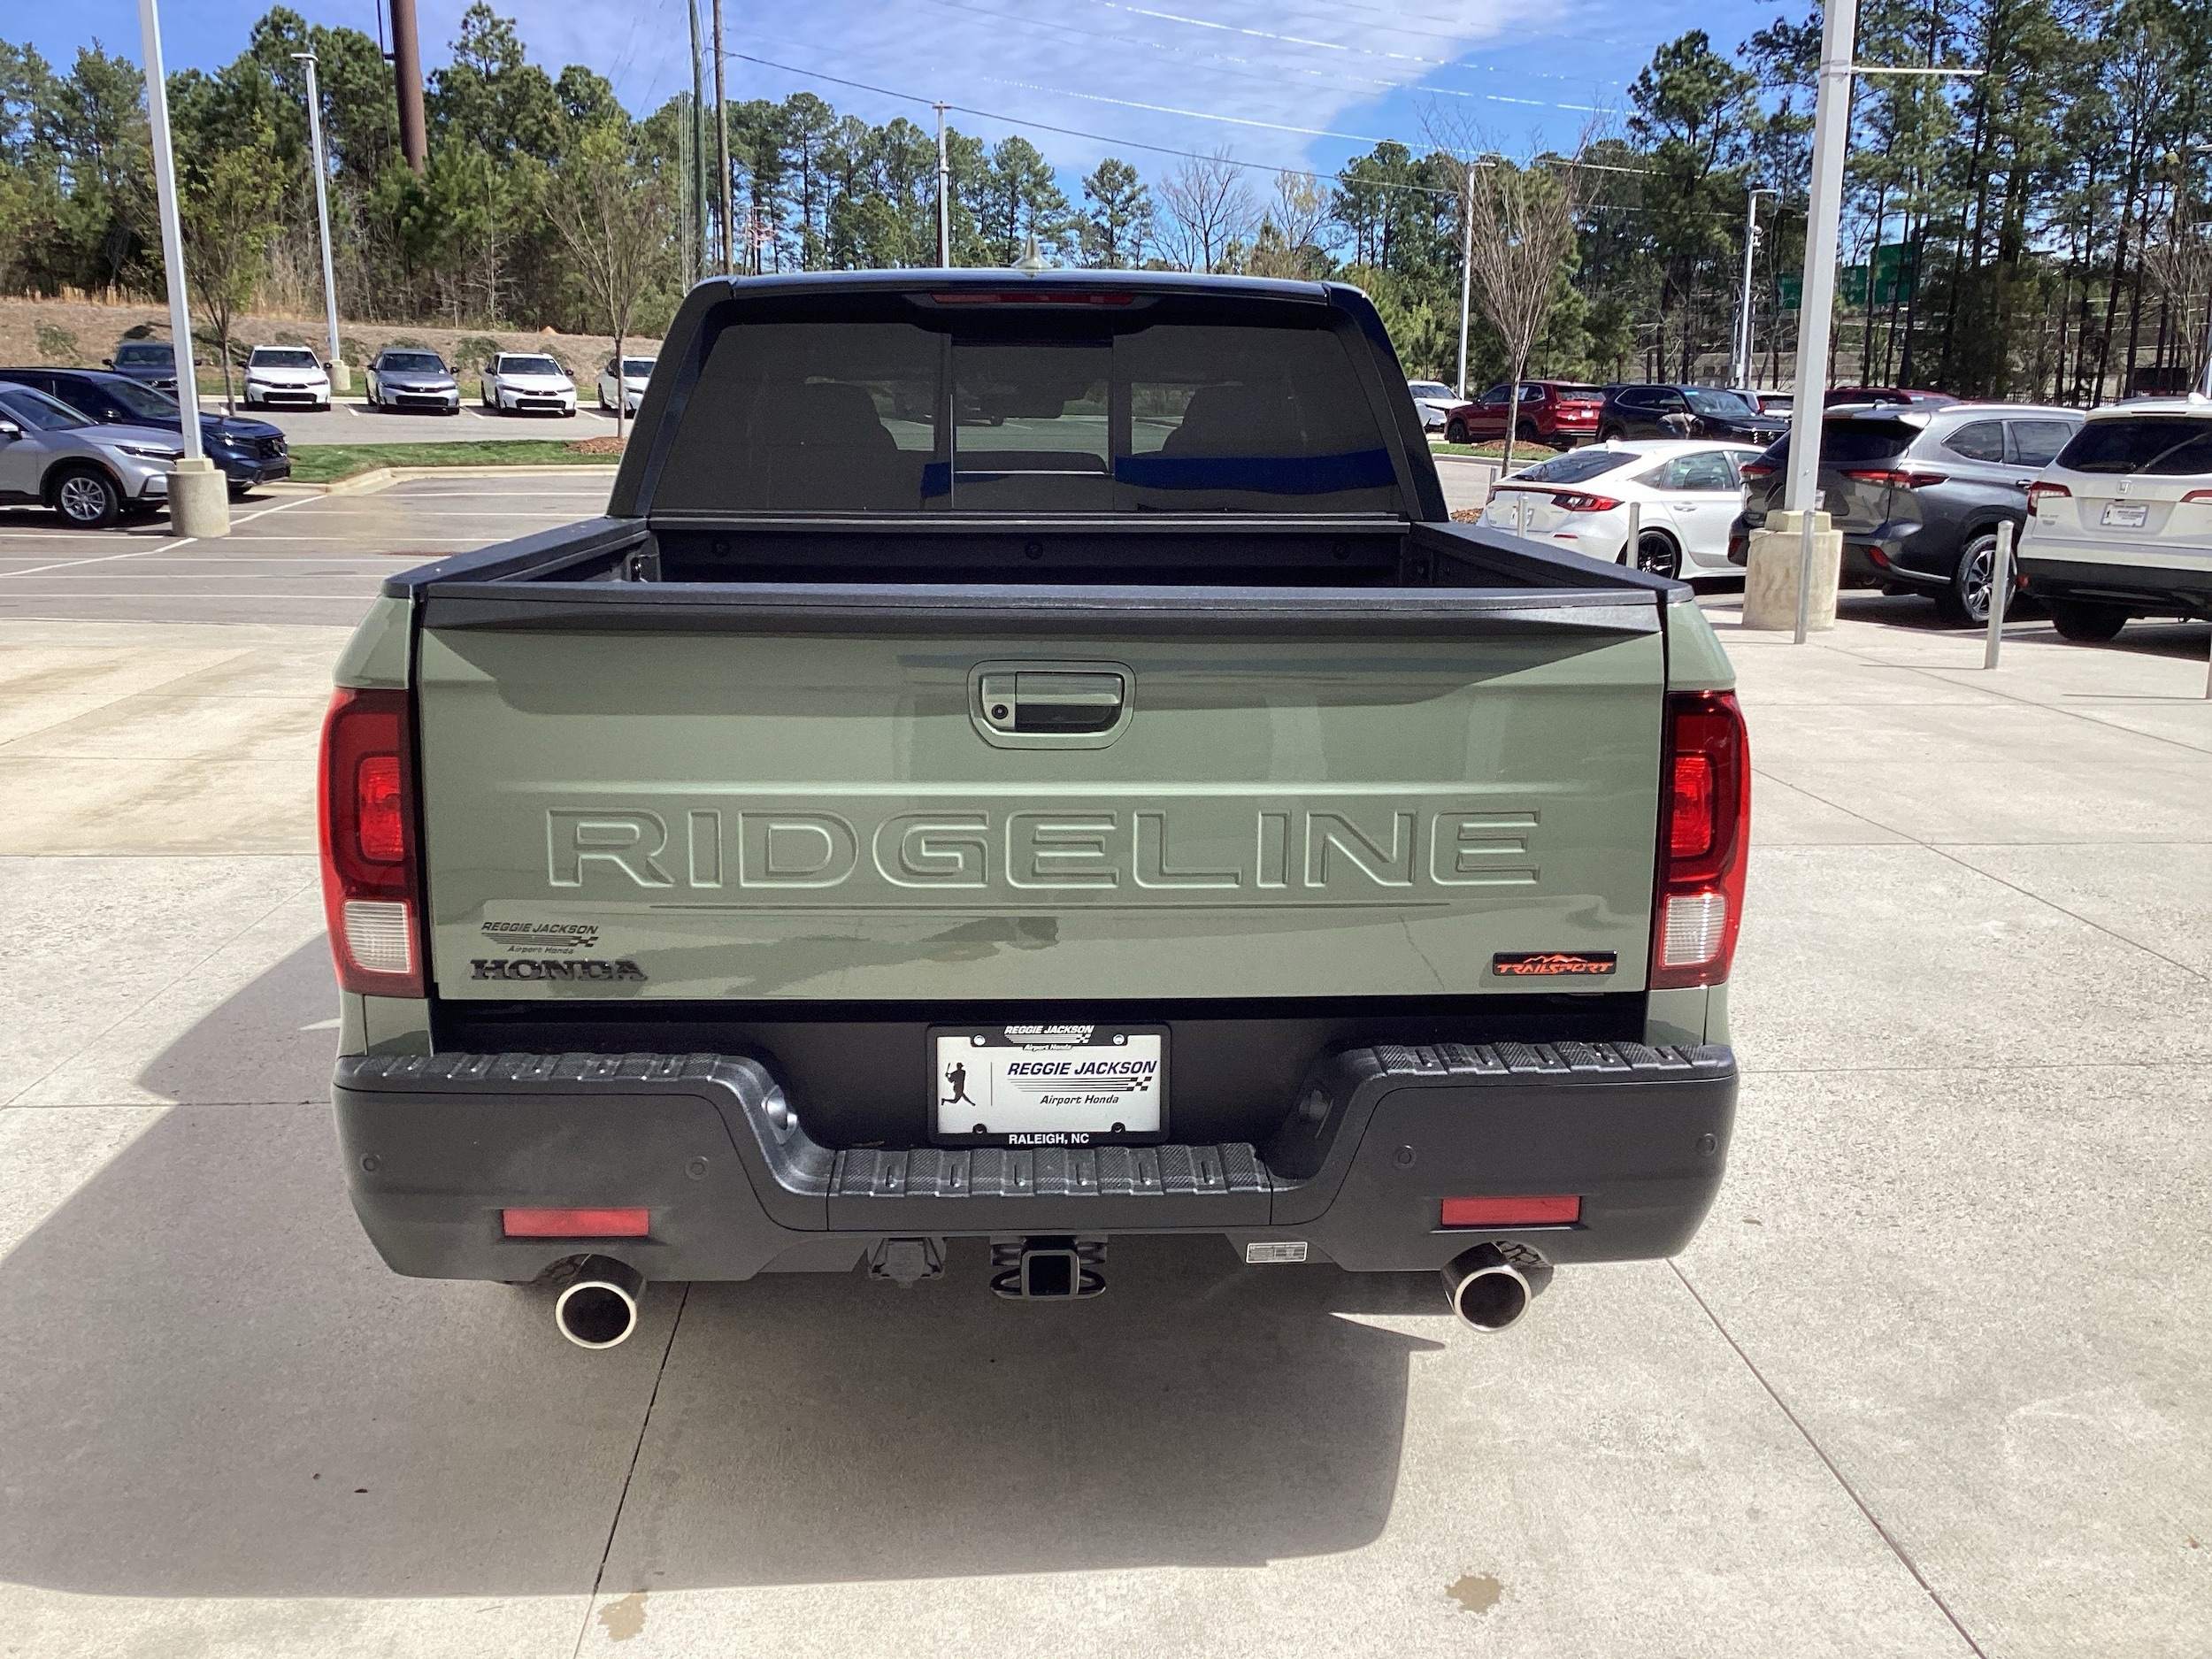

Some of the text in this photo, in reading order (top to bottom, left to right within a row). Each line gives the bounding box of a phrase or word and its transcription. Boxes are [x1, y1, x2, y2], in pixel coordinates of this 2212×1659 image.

[545, 809, 1540, 889] RIDGELINE
[481, 922, 598, 934] REGGIE JACKSON
[508, 945, 542, 954] Airport
[470, 959, 649, 981] HONDA
[1496, 963, 1614, 974] TRAILSPORT
[1004, 1025, 1094, 1035] REGGIE JACKSON
[1007, 1061, 1157, 1076] REGGIE JACKSON
[1040, 1094, 1119, 1106] Airport Honda
[1009, 1133, 1089, 1145] RALEIGH, NC
